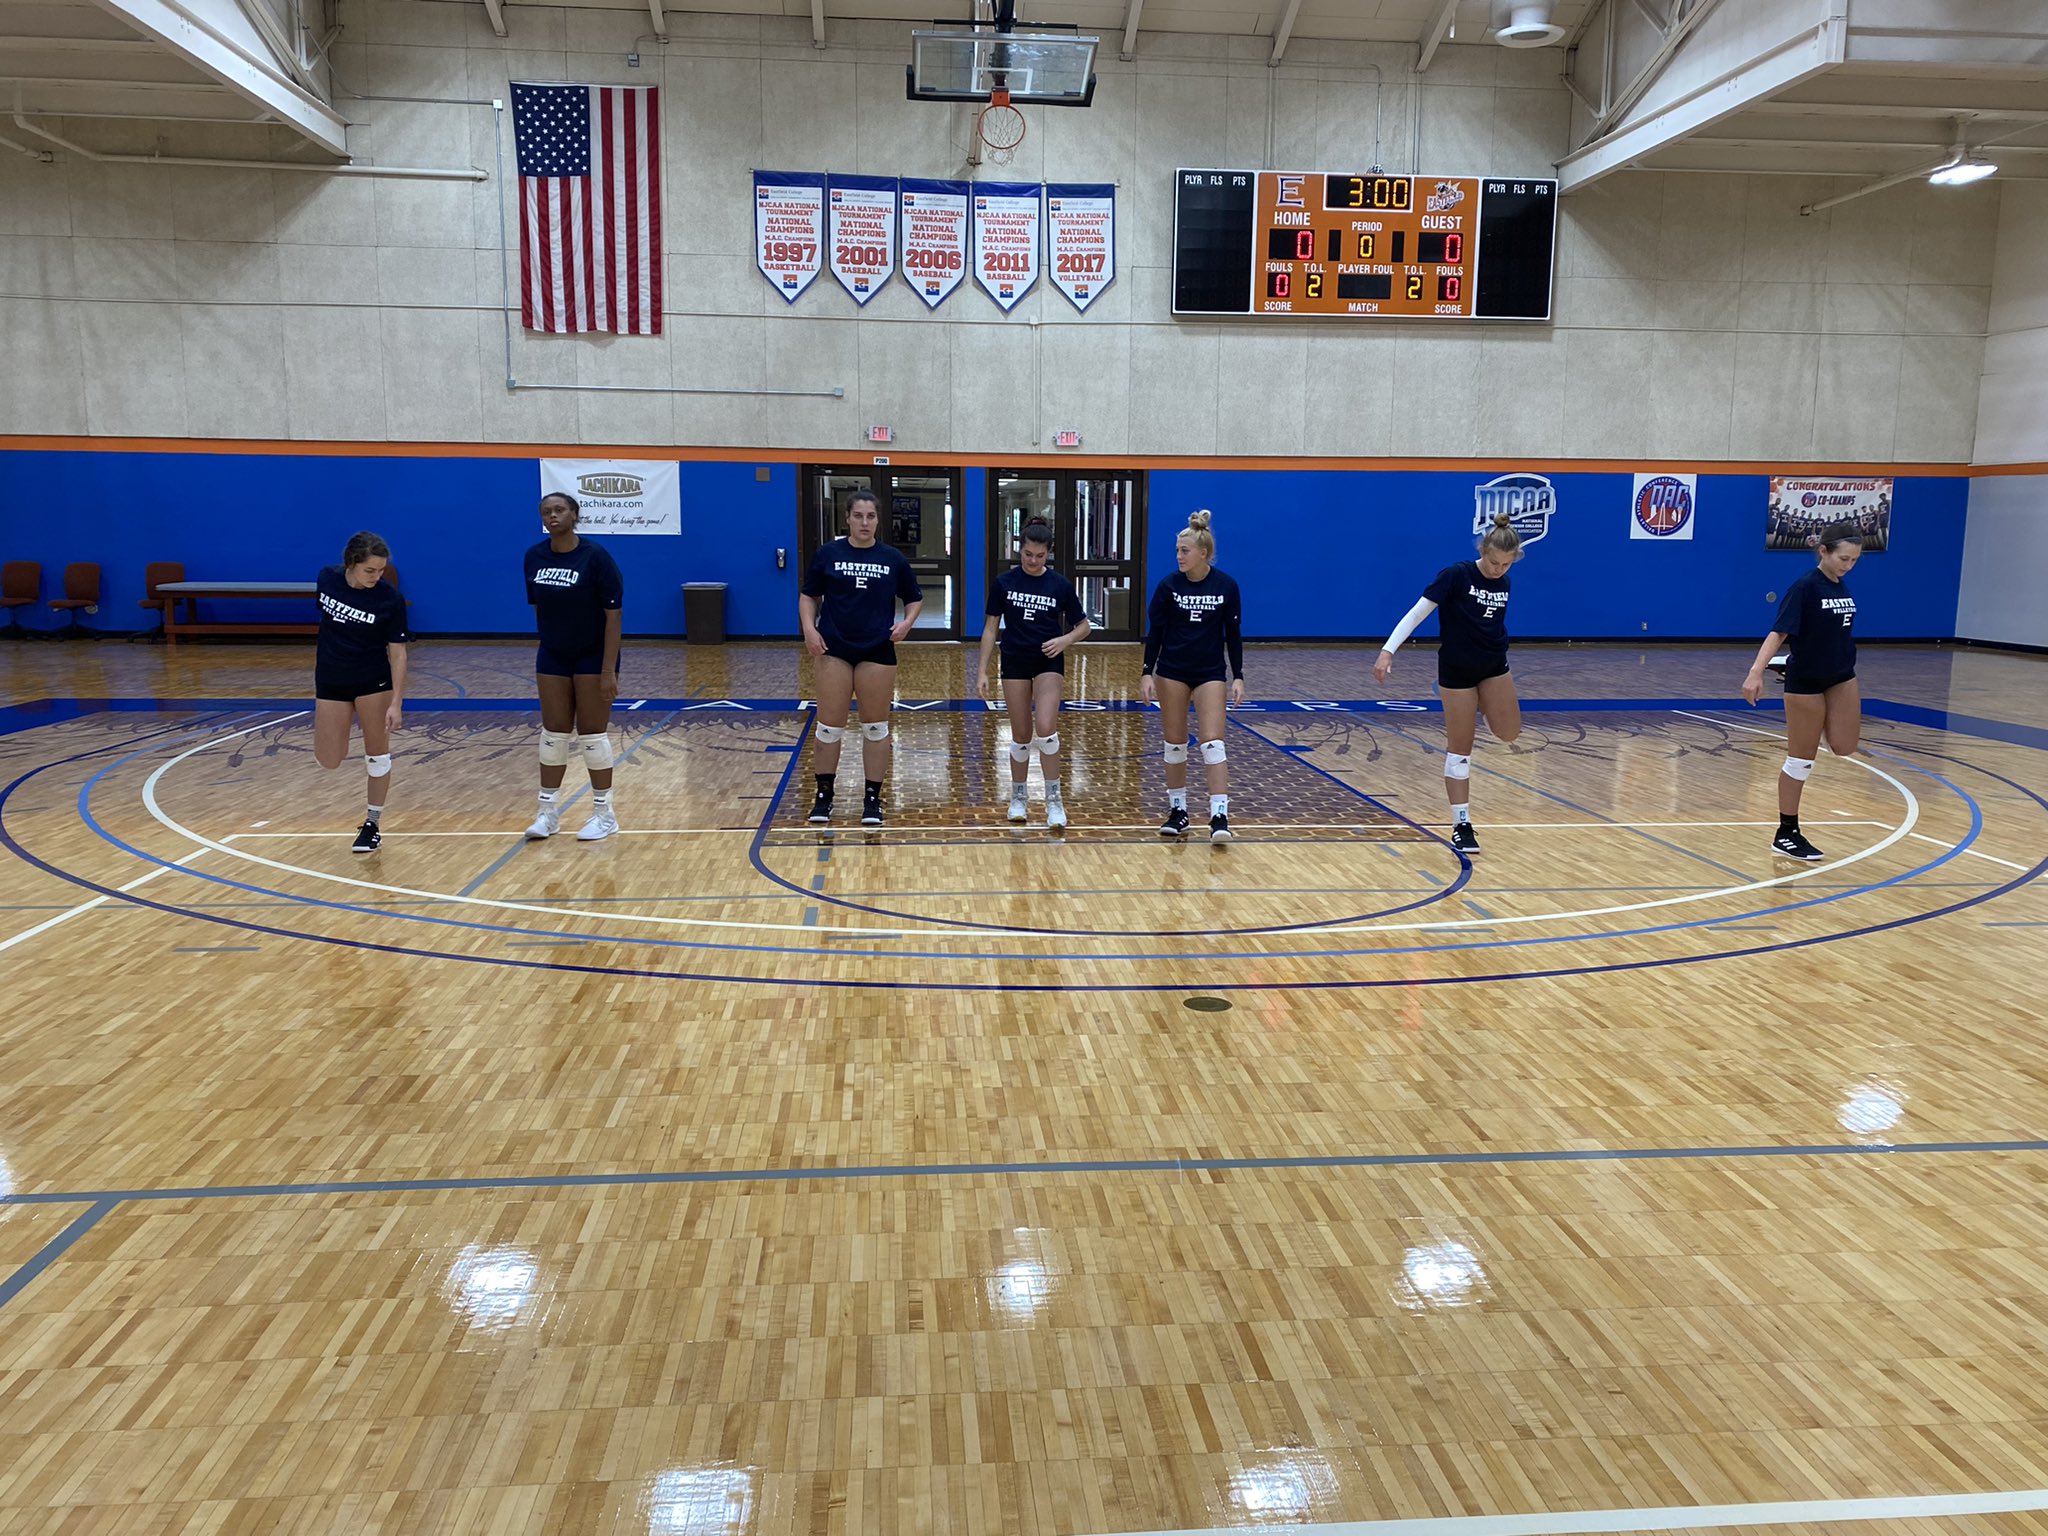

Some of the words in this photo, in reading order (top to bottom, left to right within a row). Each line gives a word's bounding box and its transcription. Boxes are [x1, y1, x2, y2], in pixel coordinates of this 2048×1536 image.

[1184, 175, 1203, 185] PLYR
[1210, 175, 1223, 186] FLS
[1232, 176, 1246, 186] PTS
[1276, 175, 1305, 208] E
[1349, 178, 1408, 208] 3:00
[1488, 183, 1506, 194] PLYR
[1513, 184, 1526, 194] FLS
[1535, 184, 1548, 195] PTS
[758, 201, 783, 209] NJCAA
[784, 202, 820, 210] NATIONAL
[838, 212, 886, 220] TOURNAMENT
[904, 208, 928, 216] NJCAA
[929, 209, 964, 218] NATIONAL
[1274, 211, 1311, 226] HOME
[767, 217, 812, 226] NATIONAL
[911, 215, 958, 224] TOURNAMENT
[1421, 215, 1463, 229] GUEST
[765, 225, 814, 234] CHAMPIONS
[840, 221, 884, 230] NATIONAL
[912, 224, 955, 233] NATIONAL
[1351, 221, 1382, 231] PERIOD
[837, 229, 886, 238] CHAMPIONS
[909, 232, 958, 242] CHAMPIONS
[985, 227, 1028, 236] NATIONAL
[1060, 228, 1102, 236] NATIONAL
[982, 235, 1031, 244] CHAMPIONS
[1056, 236, 1105, 244] CHAMPIONS
[1296, 230, 1313, 259] 0
[1359, 234, 1373, 258] 0
[1445, 234, 1462, 263] 0
[763, 242, 817, 263] 1997
[836, 245, 888, 266] 2001
[905, 249, 961, 270] 2006
[983, 252, 1030, 272] 2011
[1057, 254, 1105, 273] 2017
[764, 263, 816, 272] BASKETBALL
[841, 266, 882, 275] BASEBALL
[1265, 262, 1293, 272] FOULS
[1303, 262, 1327, 273] T.O.L.
[1338, 264, 1371, 274] PLAYER
[1373, 265, 1394, 275] FOUL
[1404, 265, 1427, 275] T.O.L.
[1436, 265, 1464, 275] FOULS
[913, 270, 953, 278] BASEBALL
[986, 273, 1027, 281] BASEBALL
[1275, 274, 1289, 296] 0
[1307, 274, 1321, 297] 2
[1408, 276, 1421, 299] 2
[1445, 277, 1459, 300] 0
[1264, 301, 1292, 311] SCORE
[1348, 303, 1378, 312] MATCH
[1434, 304, 1462, 314] SCORE
[872, 426, 889, 439] EXIT
[1060, 431, 1076, 443] EXIT
[577, 473, 643, 495] TACHIKARA
[1786, 481, 1876, 491] CONGRATULATIONS
[580, 499, 643, 508] tachikara.com
[1817, 495, 1856, 505] CO-CHAMPS
[834, 561, 890, 575] EASTFIELD
[843, 570, 881, 578] VOLLEYBALL
[855, 576, 868, 589] E
[1006, 591, 1057, 608] EASTFIELD
[1172, 592, 1224, 605] EASTFIELD
[1821, 598, 1856, 609] EASTFI
[319, 592, 376, 624] EASTFIELD
[1012, 601, 1049, 611] VOLLEYBALL
[1178, 603, 1216, 611] VOLLEYBALL
[1023, 608, 1036, 621] E
[1189, 609, 1202, 622] E
[1482, 606, 1497, 618] E
[1842, 613, 1852, 626] E
